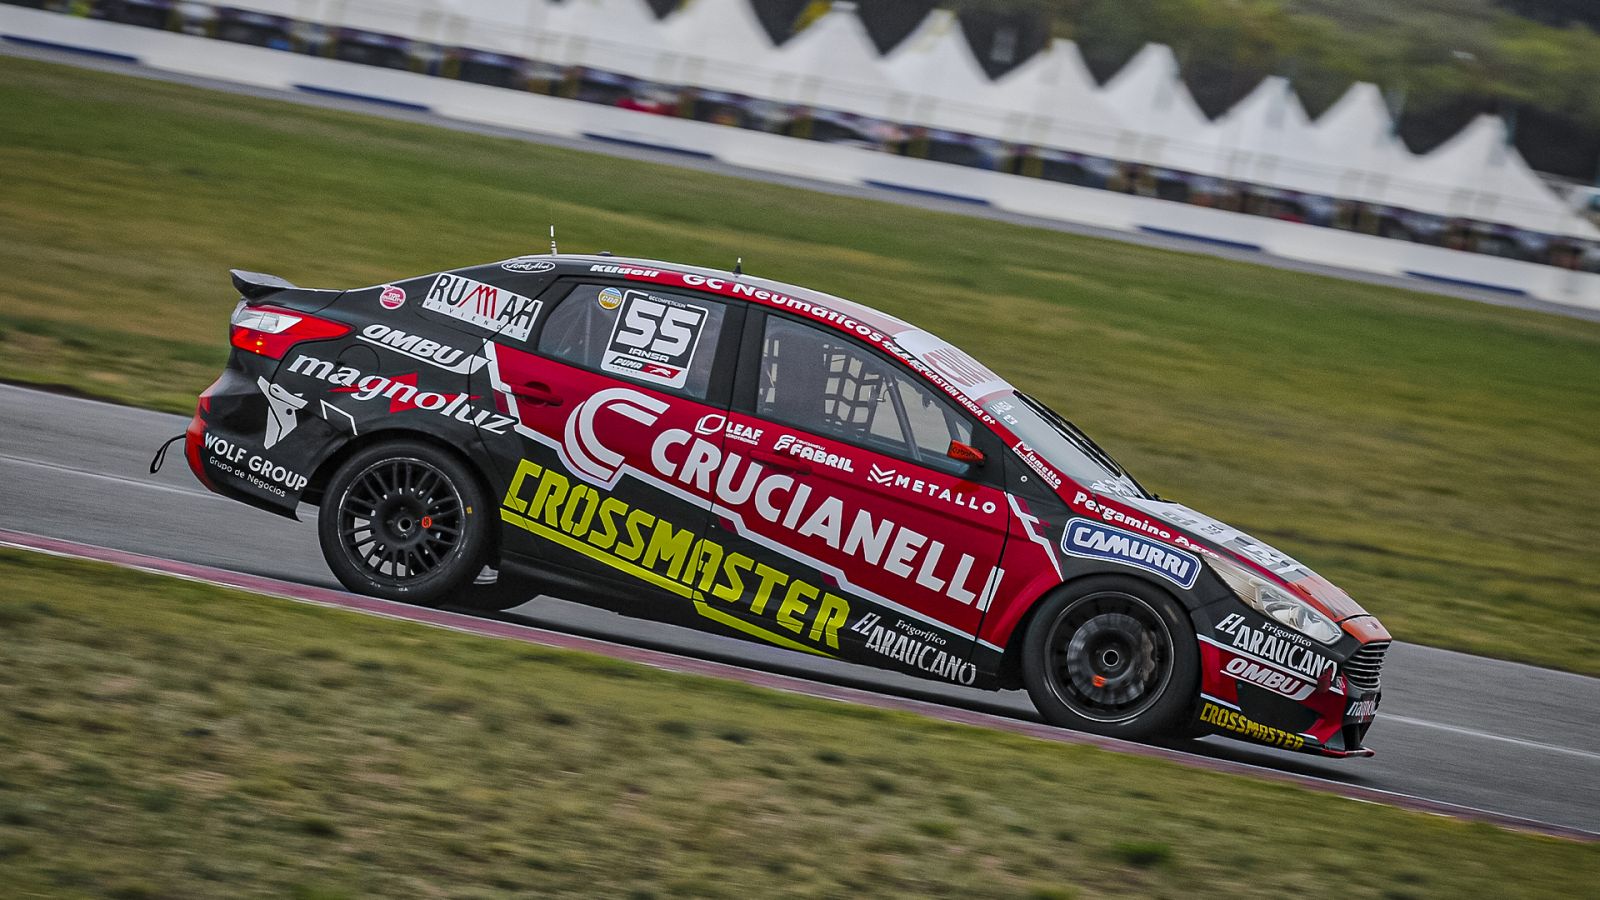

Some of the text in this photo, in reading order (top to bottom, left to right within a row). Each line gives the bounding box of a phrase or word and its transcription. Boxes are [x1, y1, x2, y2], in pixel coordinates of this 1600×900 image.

[426, 301, 527, 338] VIVIENDAS
[430, 273, 539, 331] RUMAH
[682, 273, 882, 343] GC Neumáticos
[363, 324, 464, 364] OMBU
[616, 298, 701, 357] 55
[614, 357, 643, 369] PUMA
[629, 347, 670, 362] IANSA
[287, 354, 518, 435] magnoluz
[925, 371, 959, 397] GASTÓN
[957, 393, 984, 417] IANSA
[726, 421, 764, 441] LEAF
[205, 432, 308, 491] WOLF GROUP
[209, 456, 287, 497] Grupo de Negocios
[790, 444, 854, 473] FABRIL
[895, 474, 996, 514] METALLO
[1073, 491, 1171, 540] Pergamino
[651, 428, 1005, 612] CRUCIANELLI
[502, 458, 850, 649] CROSSMASTER
[1073, 527, 1190, 579] CAMURRI
[865, 625, 976, 685] ARAUCANO
[895, 619, 947, 646] Frigorífico
[1261, 621, 1312, 647] Frigorífico
[1226, 657, 1301, 693] OMBU
[1200, 702, 1304, 750] CROSSMASTER
